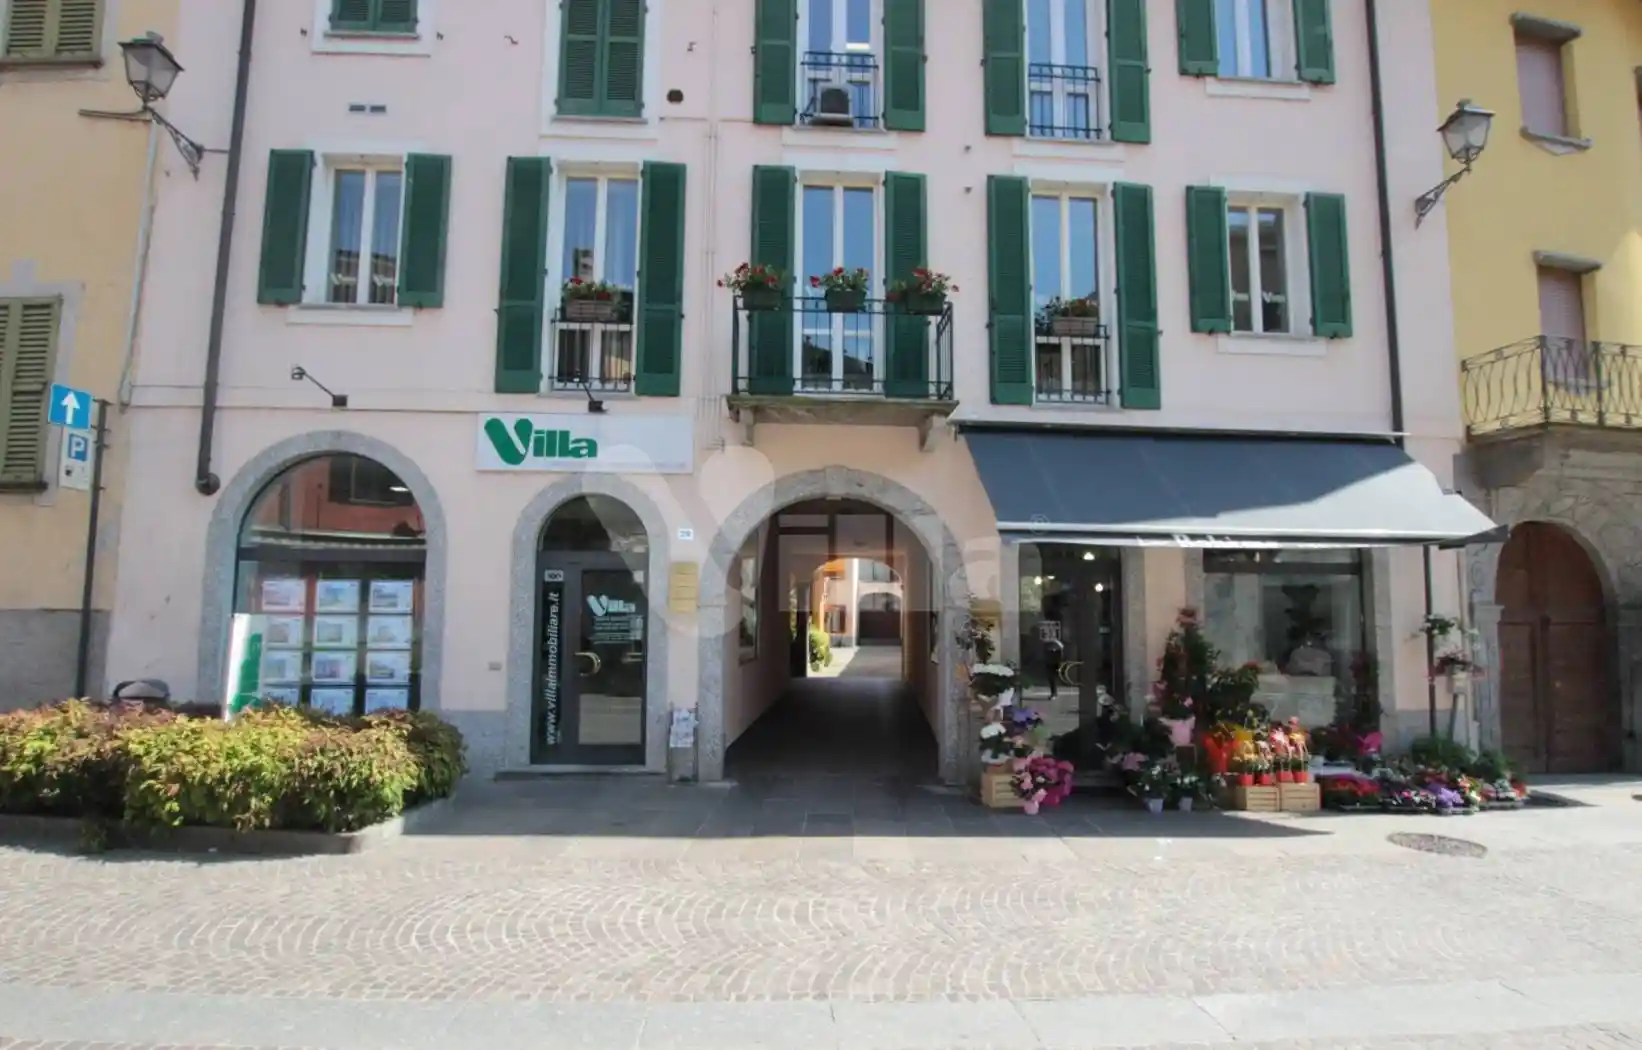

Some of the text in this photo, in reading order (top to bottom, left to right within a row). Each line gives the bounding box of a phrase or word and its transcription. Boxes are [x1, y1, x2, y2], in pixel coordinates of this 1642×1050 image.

[71, 436, 86, 457] P
[484, 417, 598, 466] Villa
[588, 595, 636, 616] Villa
